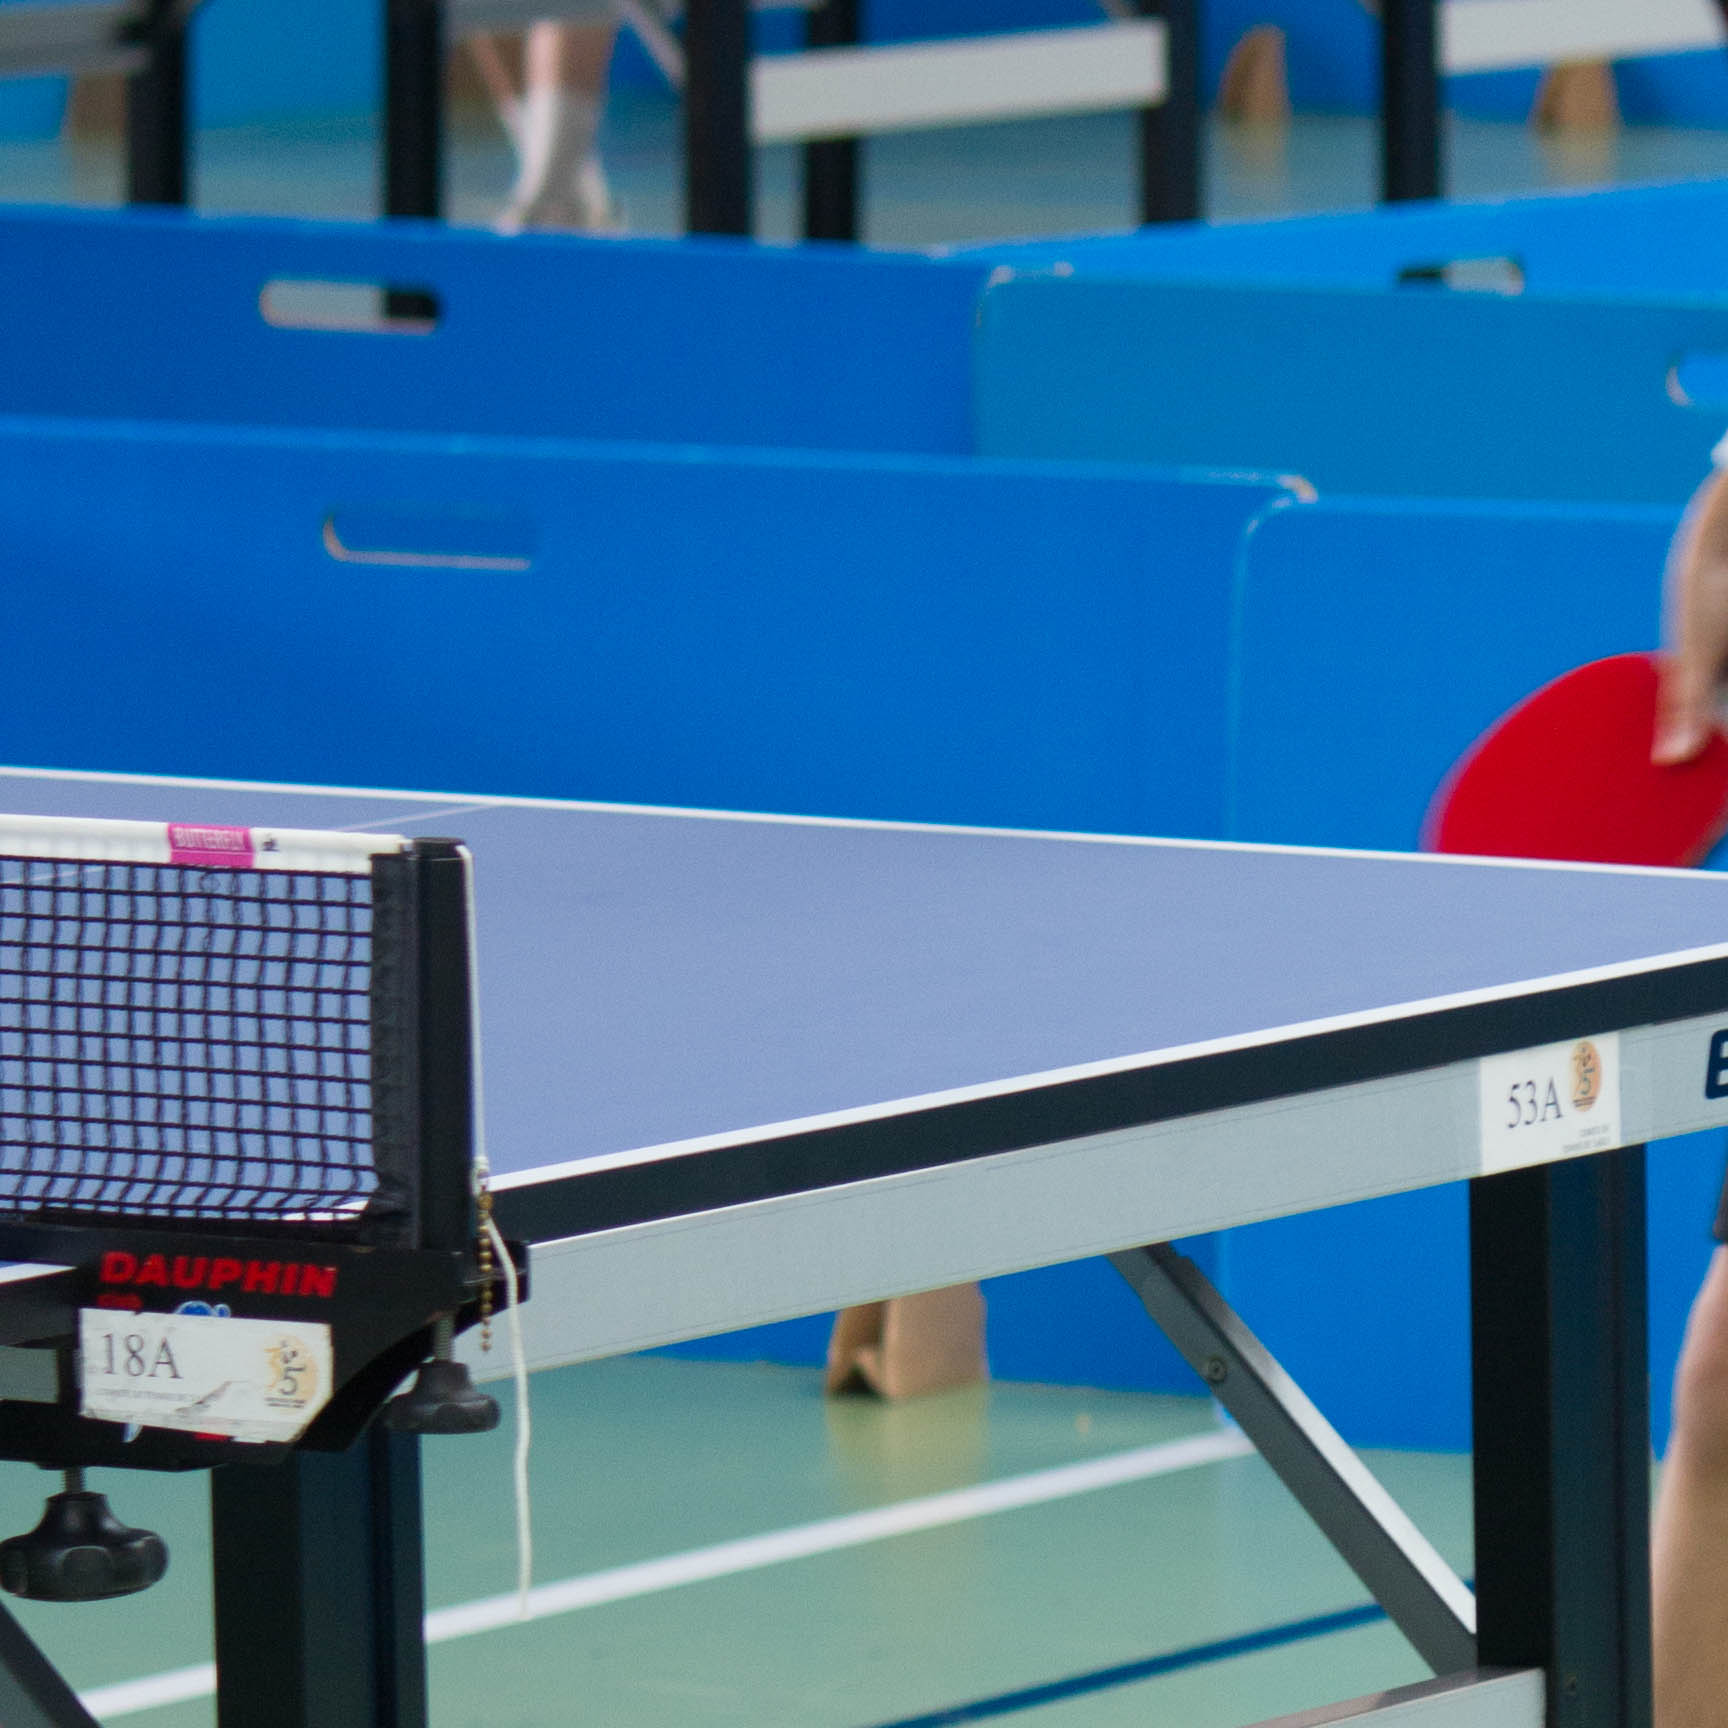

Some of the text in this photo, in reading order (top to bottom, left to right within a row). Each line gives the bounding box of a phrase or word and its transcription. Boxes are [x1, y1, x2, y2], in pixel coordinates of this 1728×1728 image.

[1507, 1076, 1563, 1129] 53A
[100, 1251, 338, 1298] DAUPHIN
[101, 1332, 183, 1379] 18A
